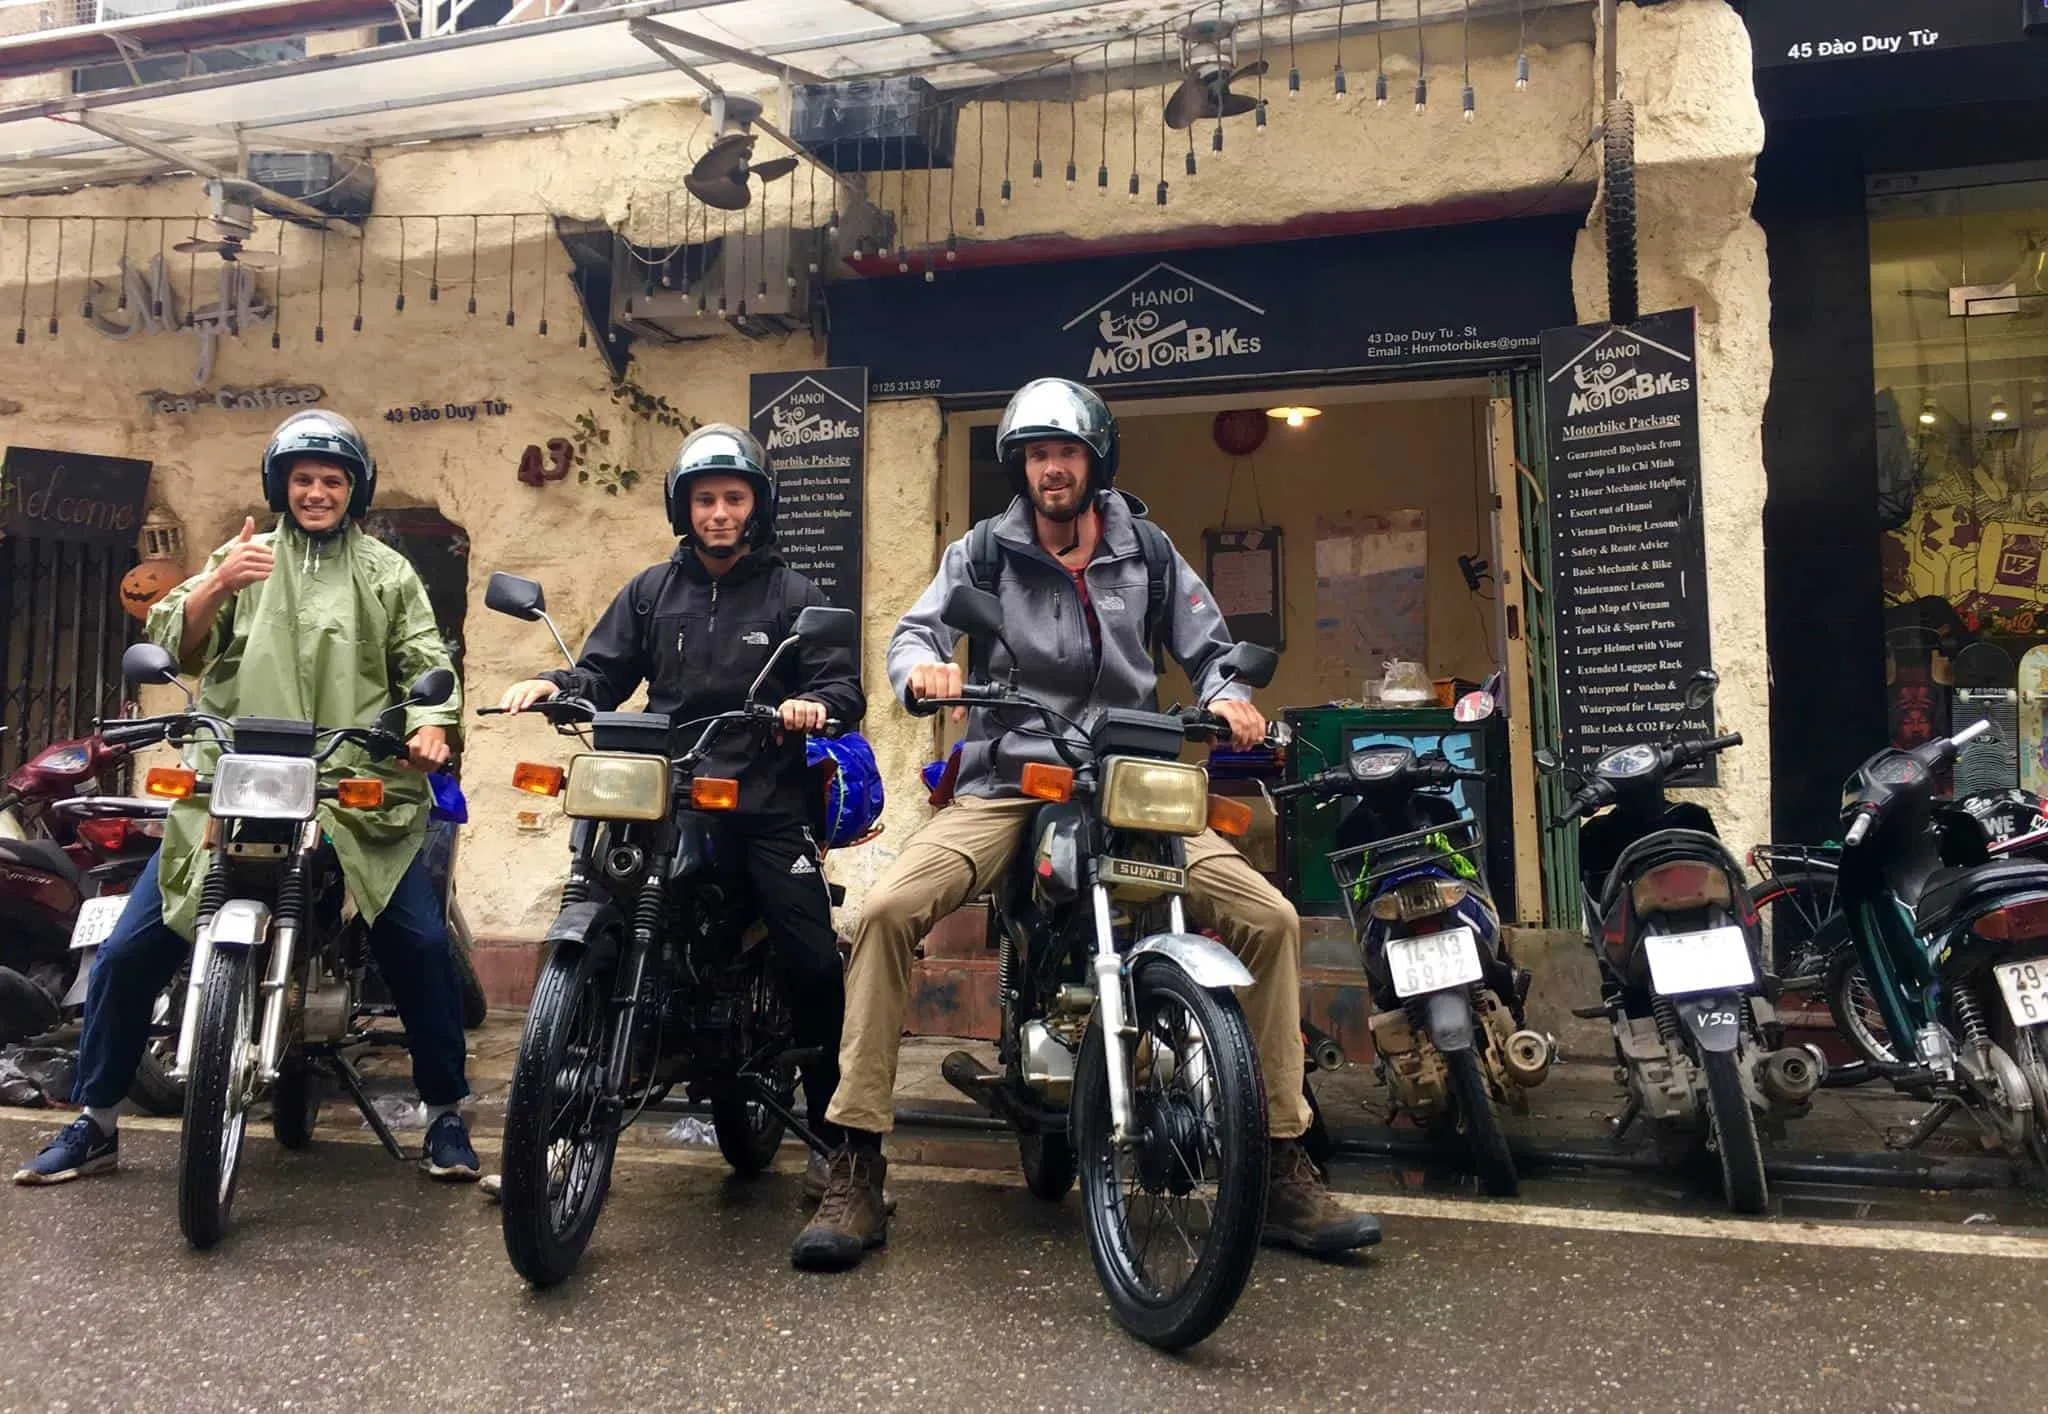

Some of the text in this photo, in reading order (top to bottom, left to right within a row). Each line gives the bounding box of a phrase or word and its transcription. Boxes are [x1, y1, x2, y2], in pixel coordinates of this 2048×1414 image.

[1787, 28, 1939, 59] 45 Đào Duy Từ
[1131, 287, 1194, 308] HANOI
[1367, 333, 1382, 344] 43
[1385, 332, 1408, 343] Dao
[1412, 330, 1436, 342] Duy
[1439, 328, 1453, 339] Tu
[1464, 326, 1477, 336] St
[1367, 346, 1401, 358] Email
[1595, 344, 1640, 361] HANOI
[872, 379, 941, 393] 0125 3133 567
[790, 393, 825, 405] HANOI
[384, 409, 404, 423] 43
[445, 404, 477, 421] Duy
[1562, 414, 1681, 438] Motorbike Package
[1567, 438, 1681, 460] Guaranteed Buyback from
[517, 437, 574, 487] 43
[812, 455, 850, 466] Package
[1568, 457, 1674, 479] our shop in Ho Chi Minh
[1569, 477, 1687, 498] 24 Hour Mechanic Helpline
[779, 495, 791, 504] hop
[812, 493, 824, 501] Chi
[826, 493, 844, 501] Minh
[776, 511, 789, 519] our
[791, 511, 821, 519] Mechanic
[1570, 500, 1652, 518] Escort out of Hanoi
[1570, 518, 1678, 537] Vietnam Driving Lessons
[791, 544, 816, 554] Driving
[1570, 539, 1670, 558] Safety & Route Advice
[791, 561, 811, 569] Route
[813, 560, 835, 569] Advice
[1572, 559, 1673, 577] Basic Mechanic & Bike
[1574, 580, 1665, 596] Maintenance Lessons
[1574, 599, 1670, 616] Road Map of Vietnam
[1576, 620, 1675, 635] Tool Kit & Spare Parts
[1576, 639, 1684, 657] Large Helmet with Visor
[1577, 660, 1683, 675] Extended Luggage Rack
[1578, 683, 1629, 696] Waterproof
[1667, 680, 1677, 690] &
[1579, 698, 1686, 714] Waterproof for Luggage
[1580, 724, 1600, 734] Bike
[1602, 723, 1624, 733] Lock
[1625, 723, 1635, 733] &
[1636, 721, 1657, 732] CO2
[1683, 719, 1708, 731] Mask
[1982, 815, 2016, 836] WE
